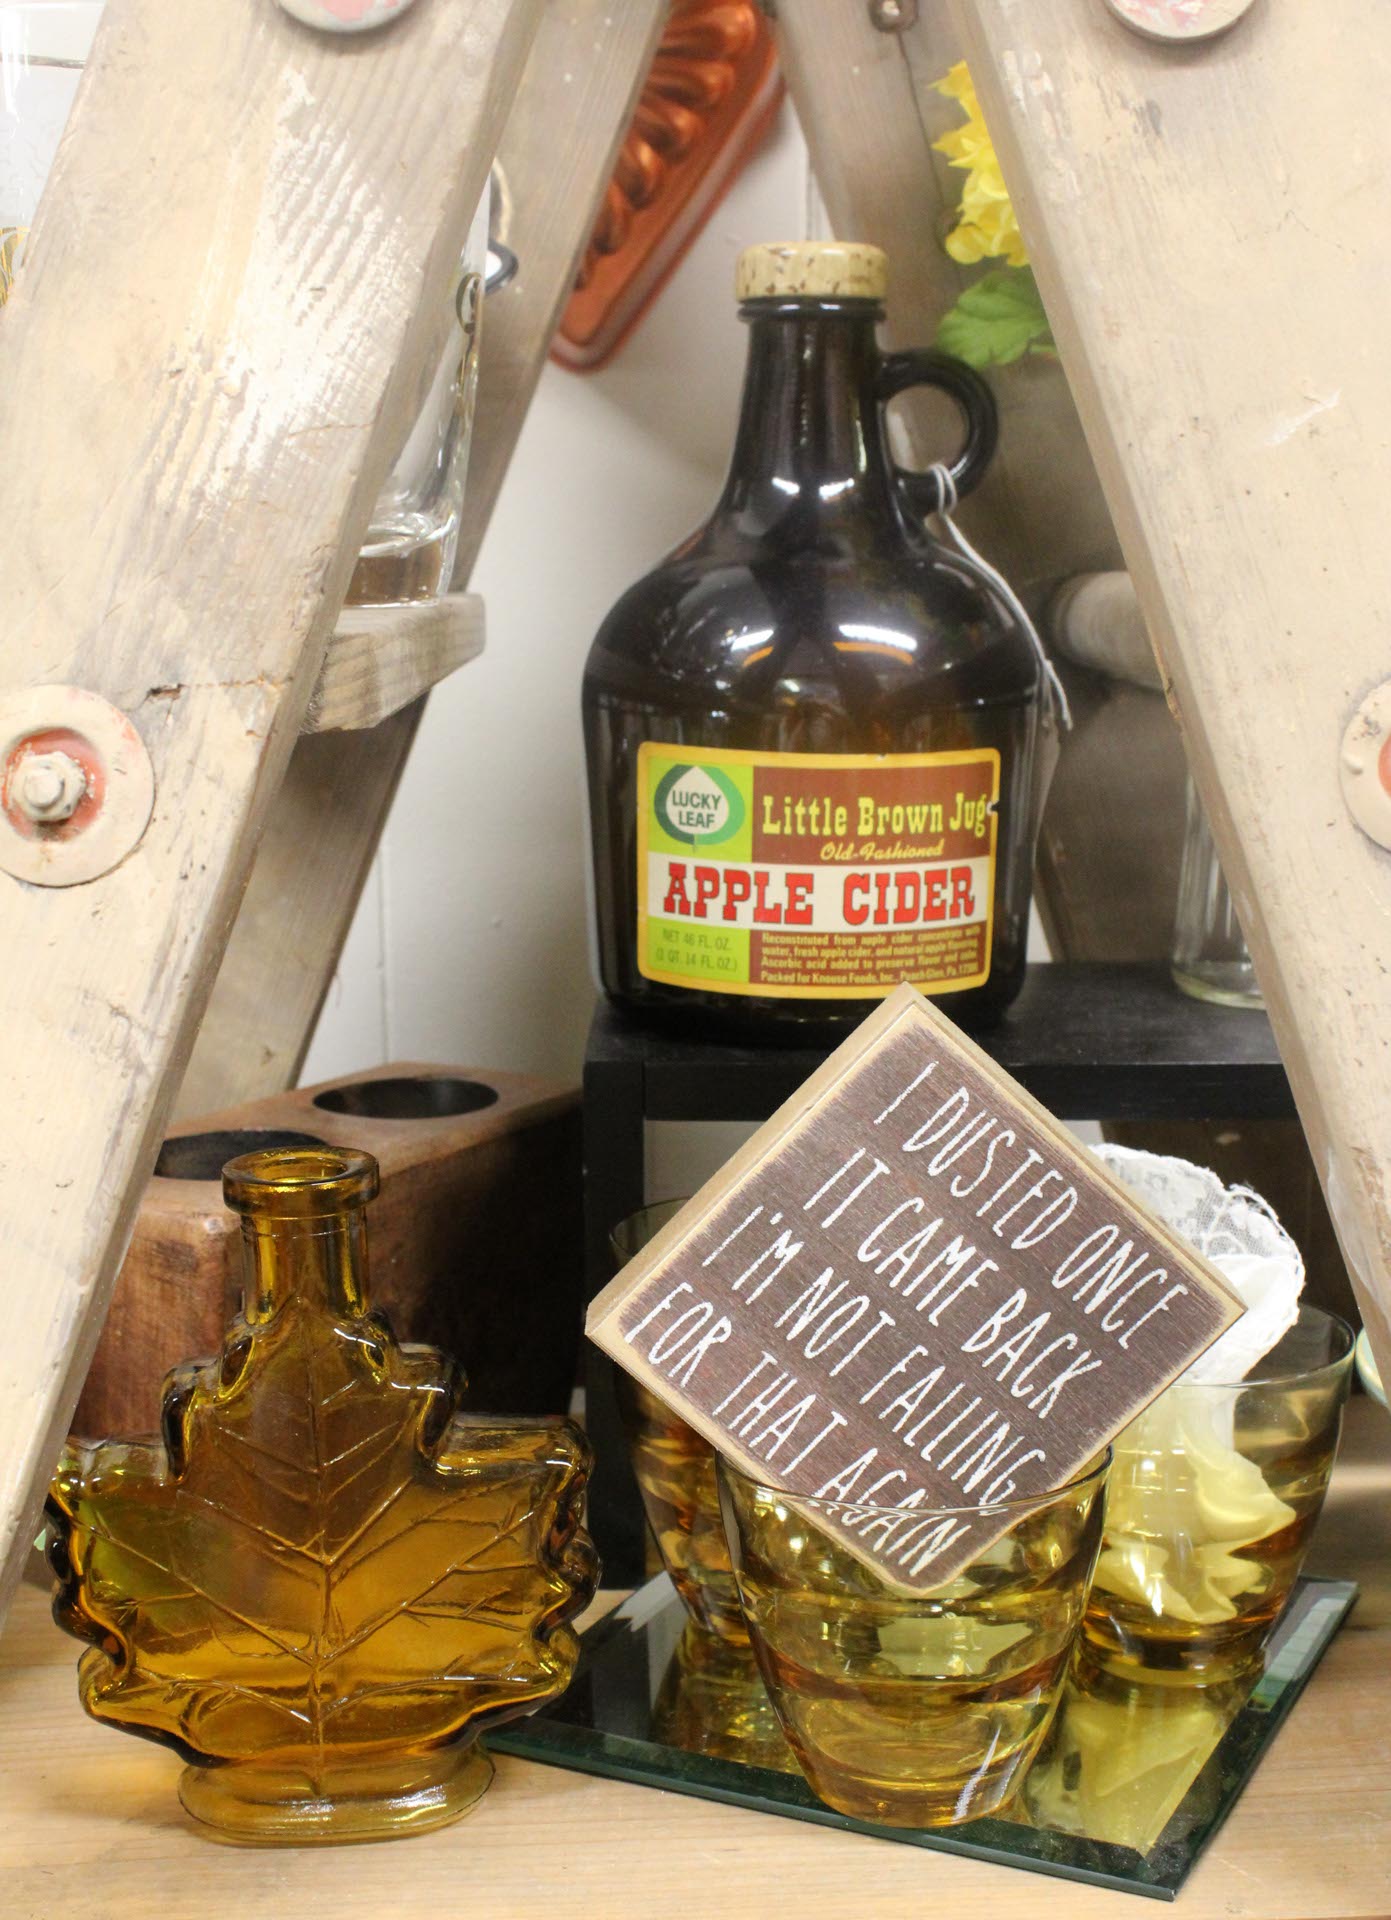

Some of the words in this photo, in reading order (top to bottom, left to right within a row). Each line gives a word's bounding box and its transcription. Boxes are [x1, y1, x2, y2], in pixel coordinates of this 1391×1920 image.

[672, 790, 721, 810] LUCKY
[678, 811, 715, 829] LEAF
[762, 795, 847, 836] Little
[857, 796, 943, 837] Brown
[949, 792, 987, 838] Jug
[820, 838, 945, 861] Old-Fashioned
[663, 862, 814, 925] APPLE
[843, 866, 975, 926] CIDER
[761, 956, 802, 969] Ascorbic
[806, 958, 827, 970] acid
[834, 934, 856, 945] from
[874, 1061, 939, 1125] I
[902, 1087, 1078, 1250] DUSTED
[803, 1148, 890, 1229] IT
[857, 1197, 999, 1327] CAME
[961, 1288, 1102, 1418] BACK
[1051, 1225, 1188, 1350] ONCE
[702, 1205, 804, 1305] I'M
[774, 1266, 896, 1377] NOT
[859, 1345, 1046, 1516] FALLING
[624, 1282, 732, 1388] FOR
[712, 1350, 848, 1476] THAT
[811, 1448, 972, 1577] AGAIN
